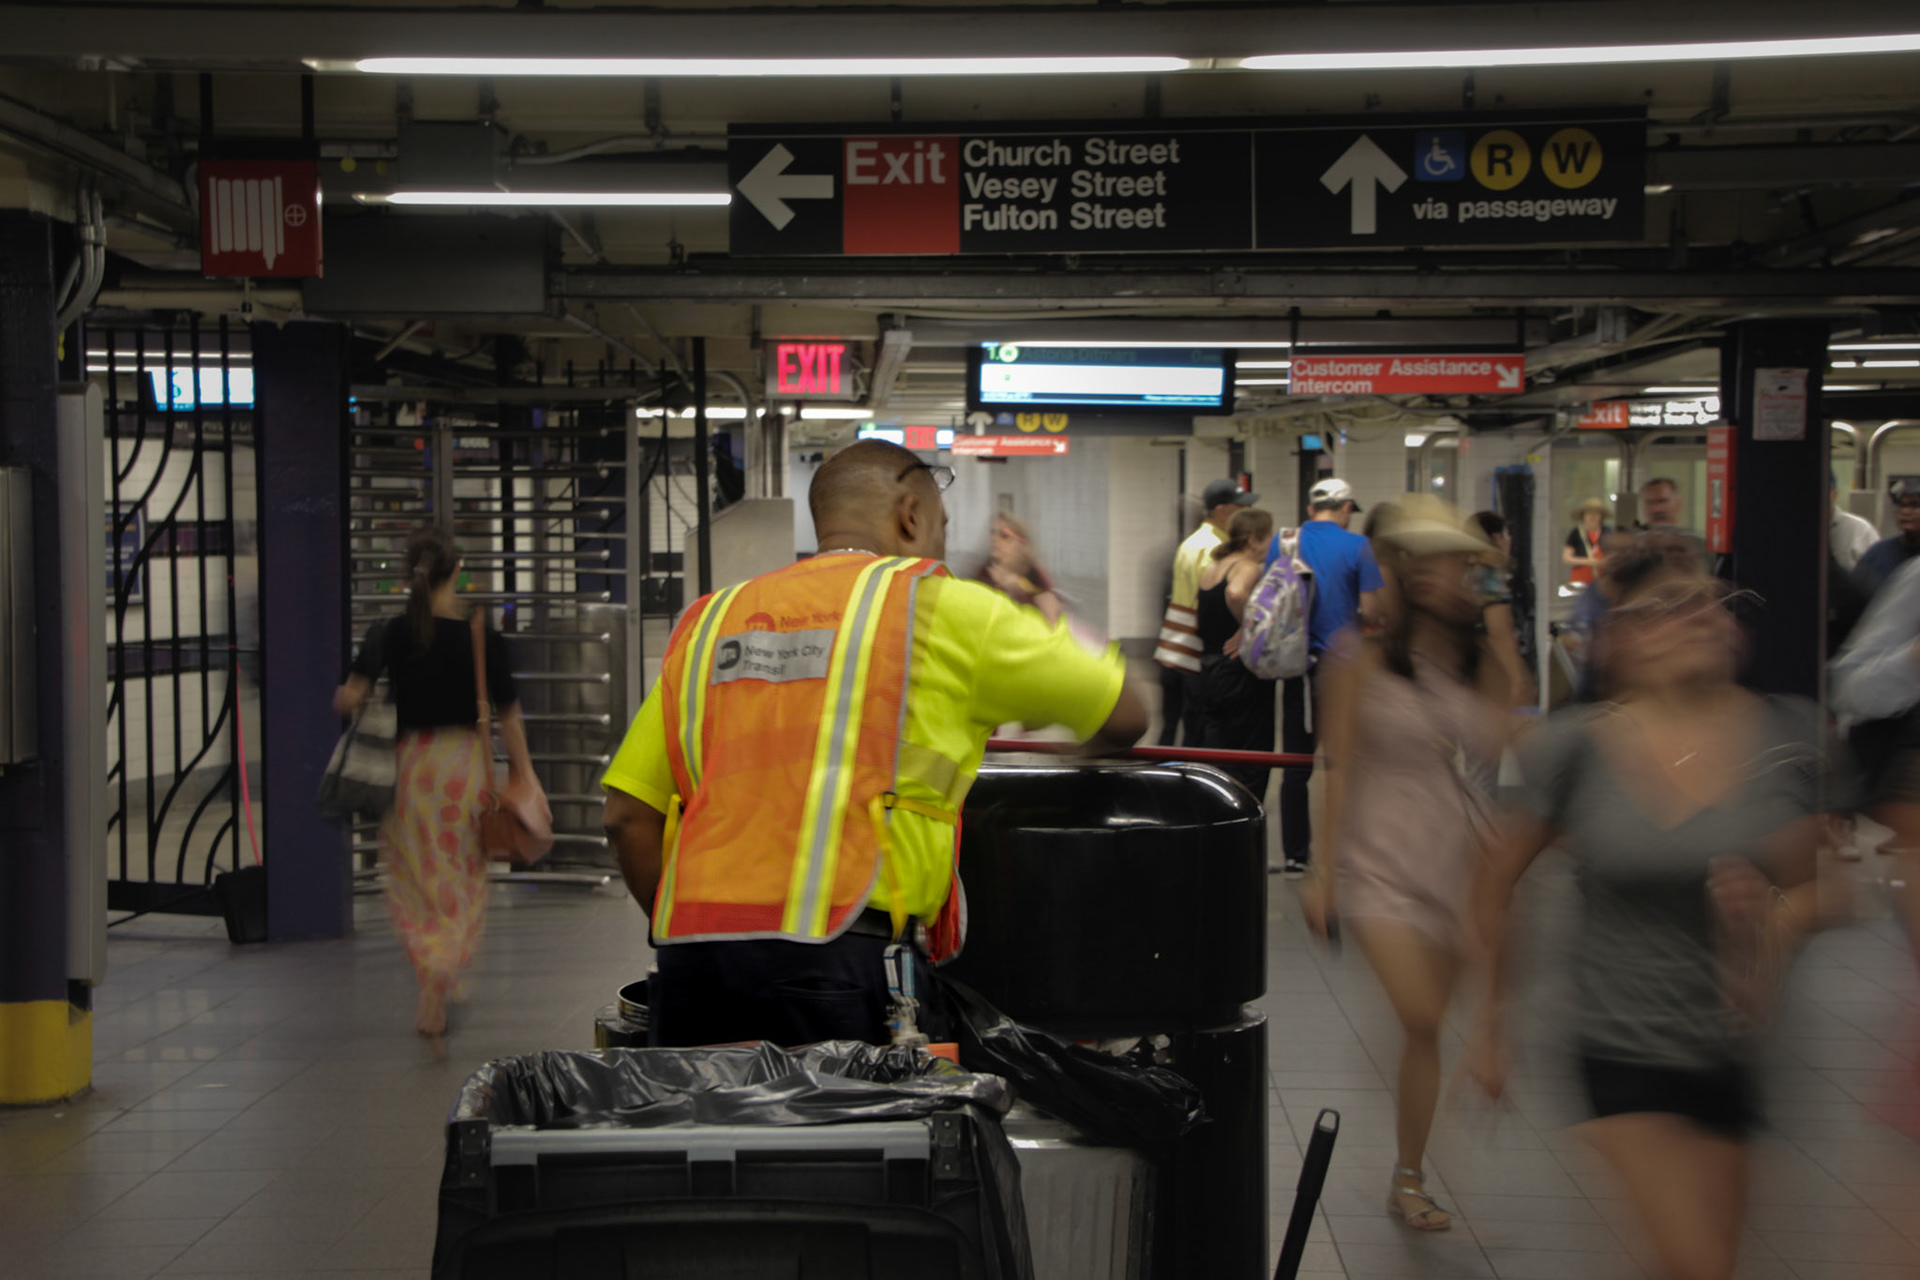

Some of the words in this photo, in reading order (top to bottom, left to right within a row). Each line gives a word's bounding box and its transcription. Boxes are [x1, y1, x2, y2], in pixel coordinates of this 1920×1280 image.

[846, 141, 946, 185] Exit
[963, 138, 1071, 168] Church
[1084, 138, 1180, 165] Street
[1487, 144, 1513, 176] R
[1551, 141, 1593, 174] W
[964, 172, 1057, 203] Vesey
[1070, 170, 1167, 199] Street
[963, 203, 1058, 232] Fulton
[1070, 202, 1166, 230] Street
[1413, 196, 1449, 219] via
[1459, 198, 1618, 222] passageway
[777, 343, 846, 394] EXIT
[1292, 360, 1383, 377] Customer
[1389, 359, 1492, 376] Assistance
[1292, 378, 1373, 394] Intercom
[744, 645, 774, 659] New
[777, 648, 798, 660] York
[802, 645, 824, 658] City
[743, 660, 787, 676] Transit
